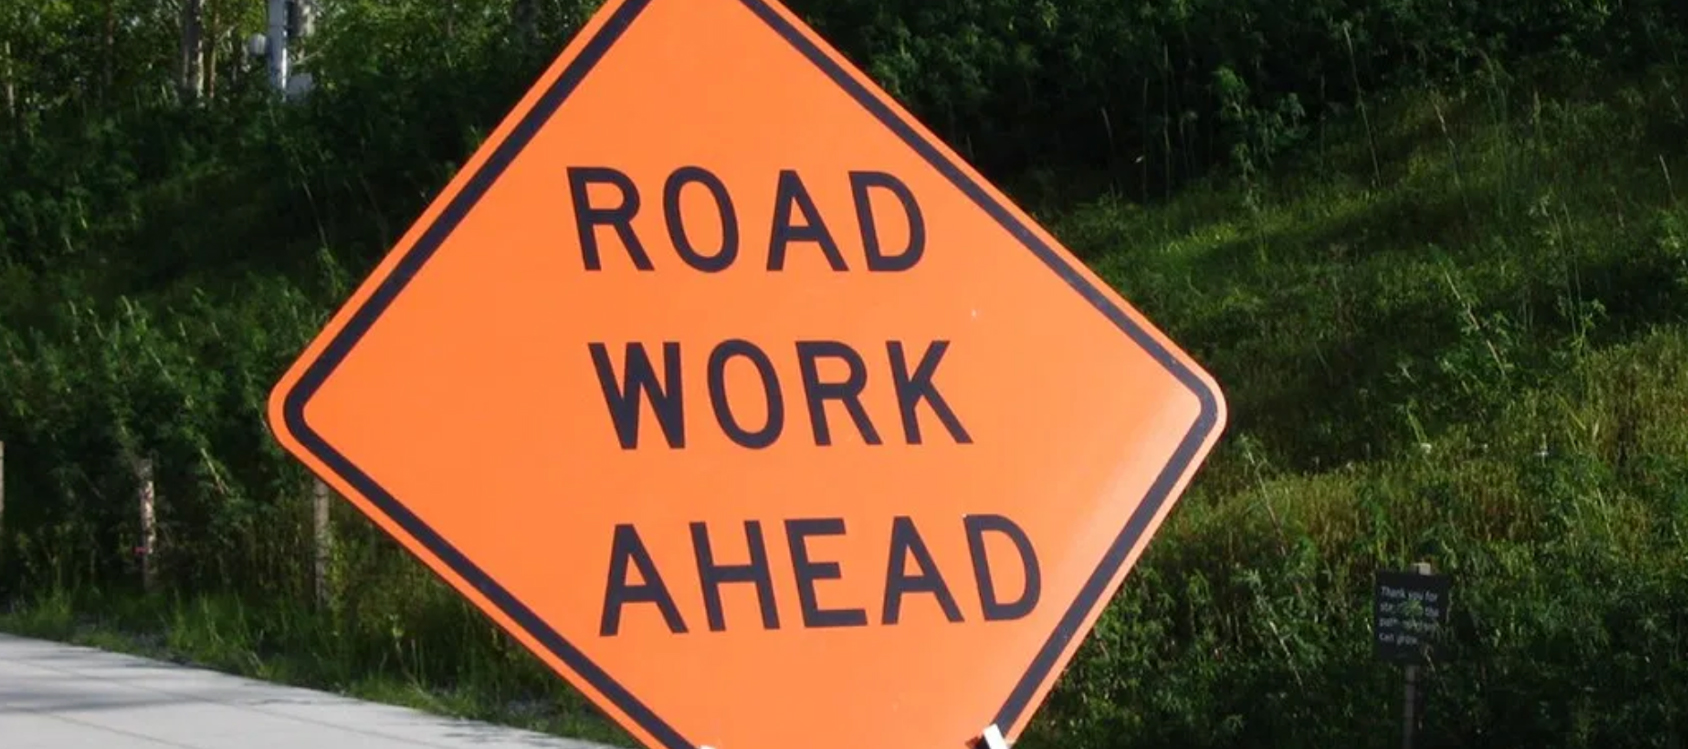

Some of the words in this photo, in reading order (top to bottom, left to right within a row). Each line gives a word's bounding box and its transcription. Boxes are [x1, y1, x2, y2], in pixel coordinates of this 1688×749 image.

[567, 166, 926, 272] ROAD
[588, 339, 972, 450] WORK
[600, 514, 1041, 637] AHEAD
[1381, 586, 1405, 598] Thank
[1425, 590, 1438, 602] for
